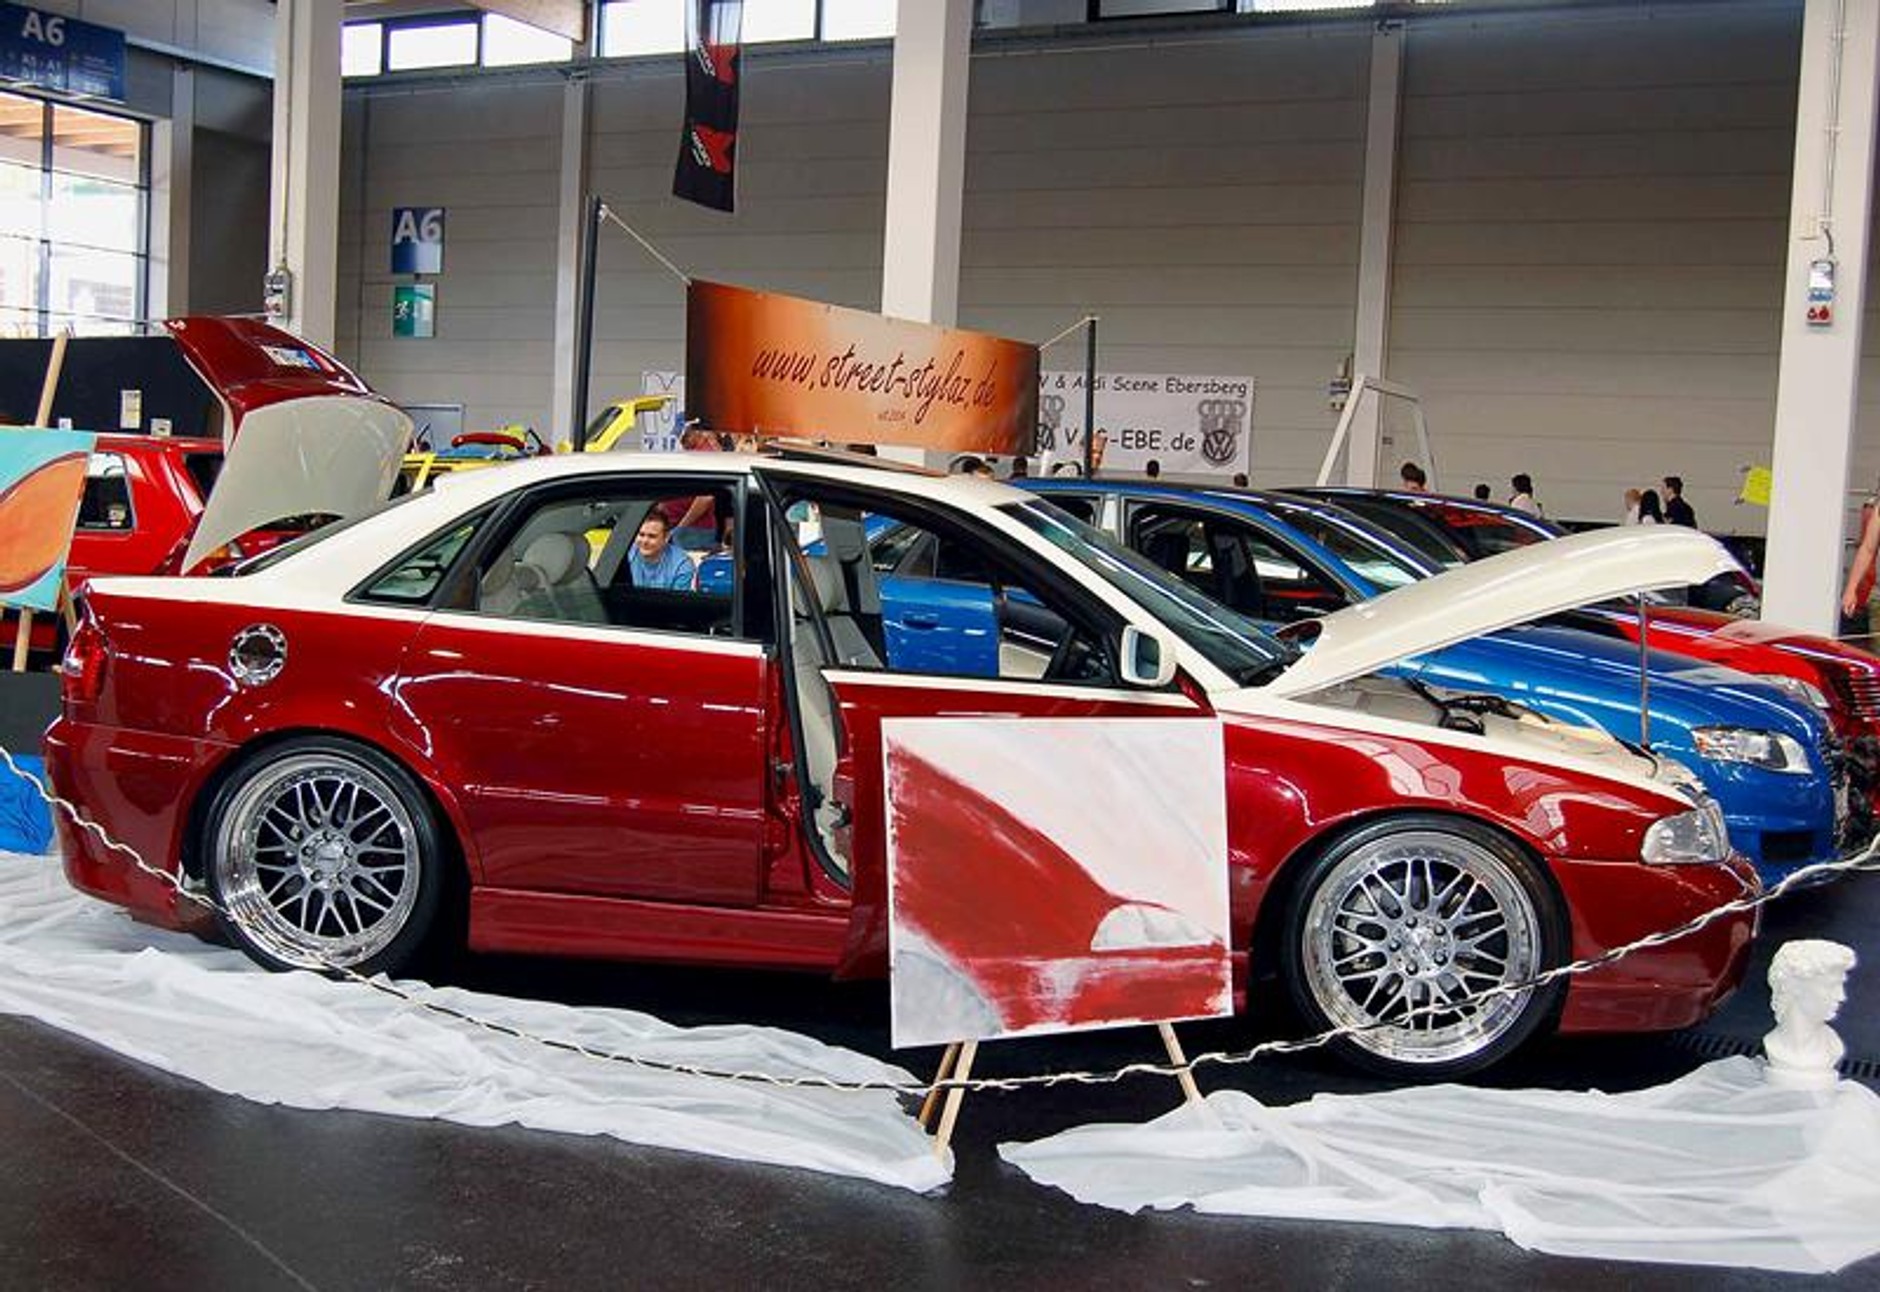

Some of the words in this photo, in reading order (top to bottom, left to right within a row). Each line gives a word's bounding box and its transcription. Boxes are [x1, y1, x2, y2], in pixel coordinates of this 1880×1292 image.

[22, 11, 65, 46] A6
[394, 208, 443, 245] A6
[1055, 374, 1066, 389] &
[1072, 375, 1106, 391] Adi
[1113, 376, 1159, 392] Scene
[1165, 377, 1247, 398] Ebersberg
